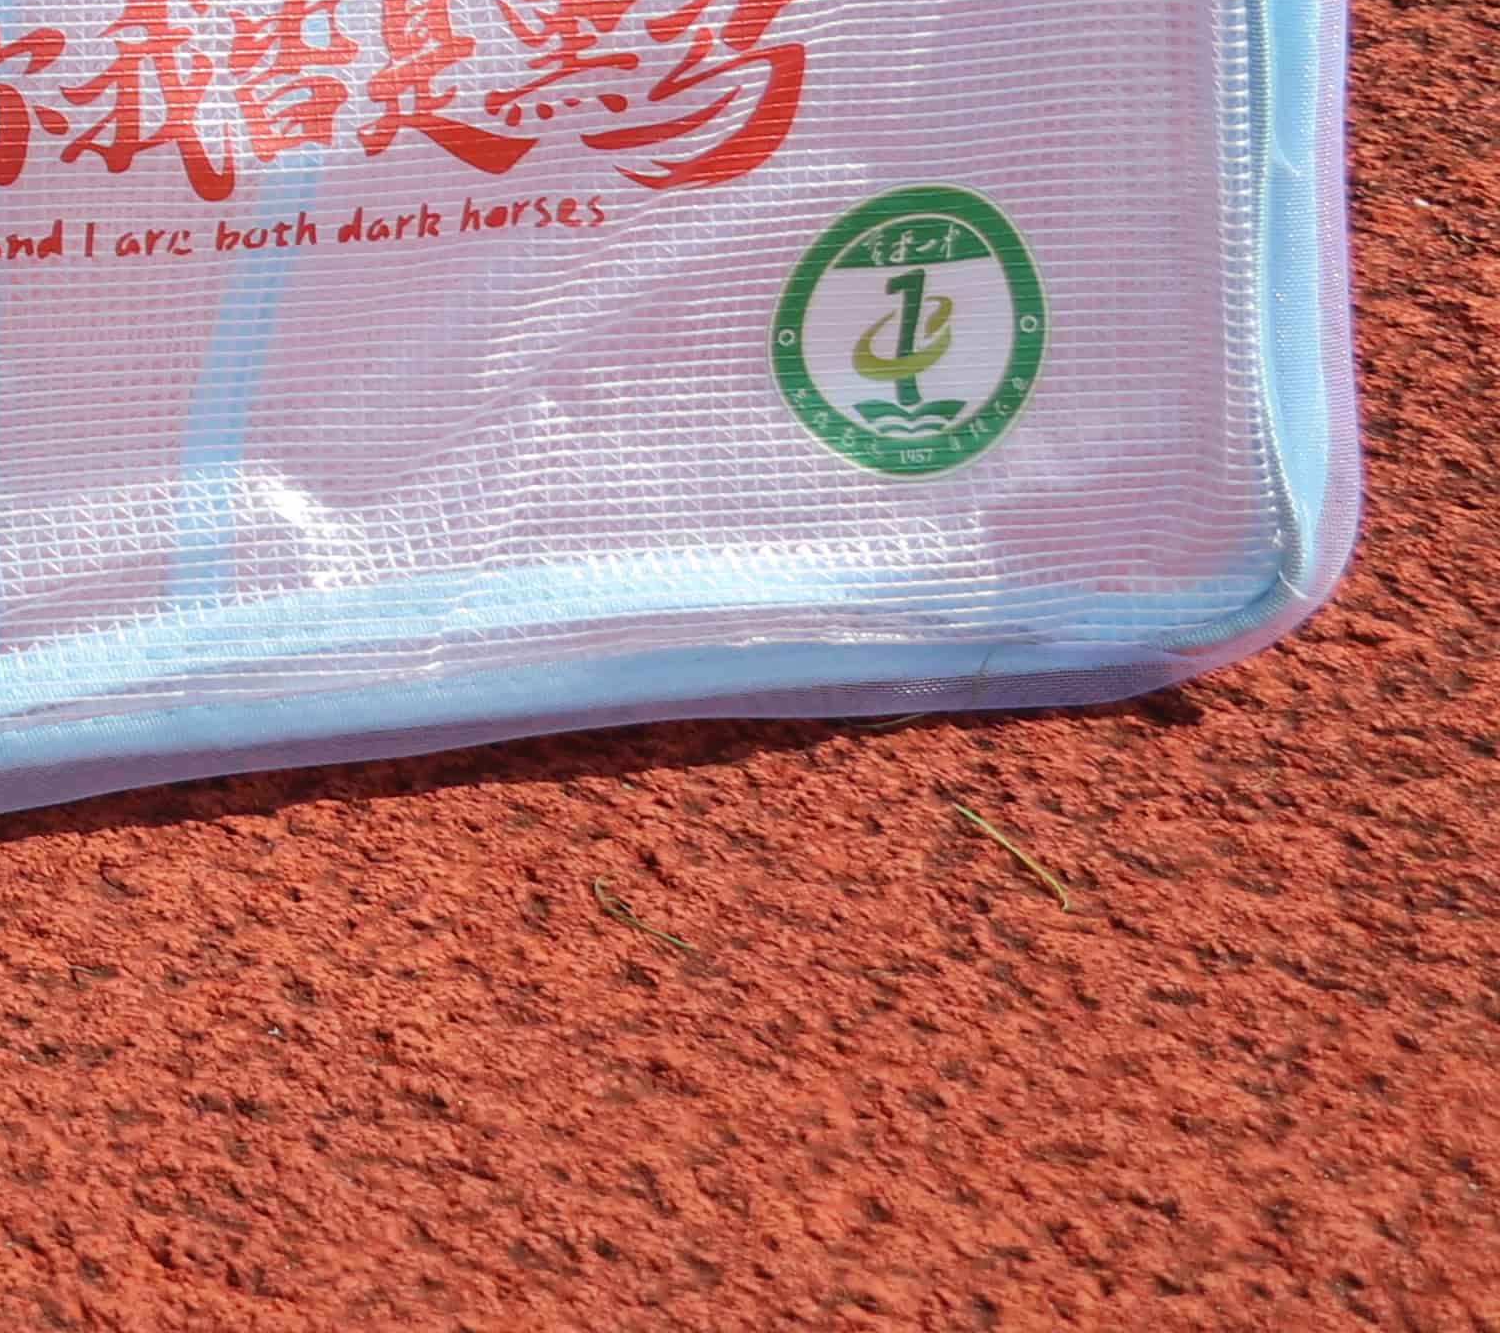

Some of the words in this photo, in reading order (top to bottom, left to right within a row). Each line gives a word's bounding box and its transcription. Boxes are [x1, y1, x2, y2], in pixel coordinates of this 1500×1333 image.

[115, 227, 192, 258] are
[215, 211, 319, 251] both
[337, 206, 442, 245] dark
[458, 193, 608, 235] horses
